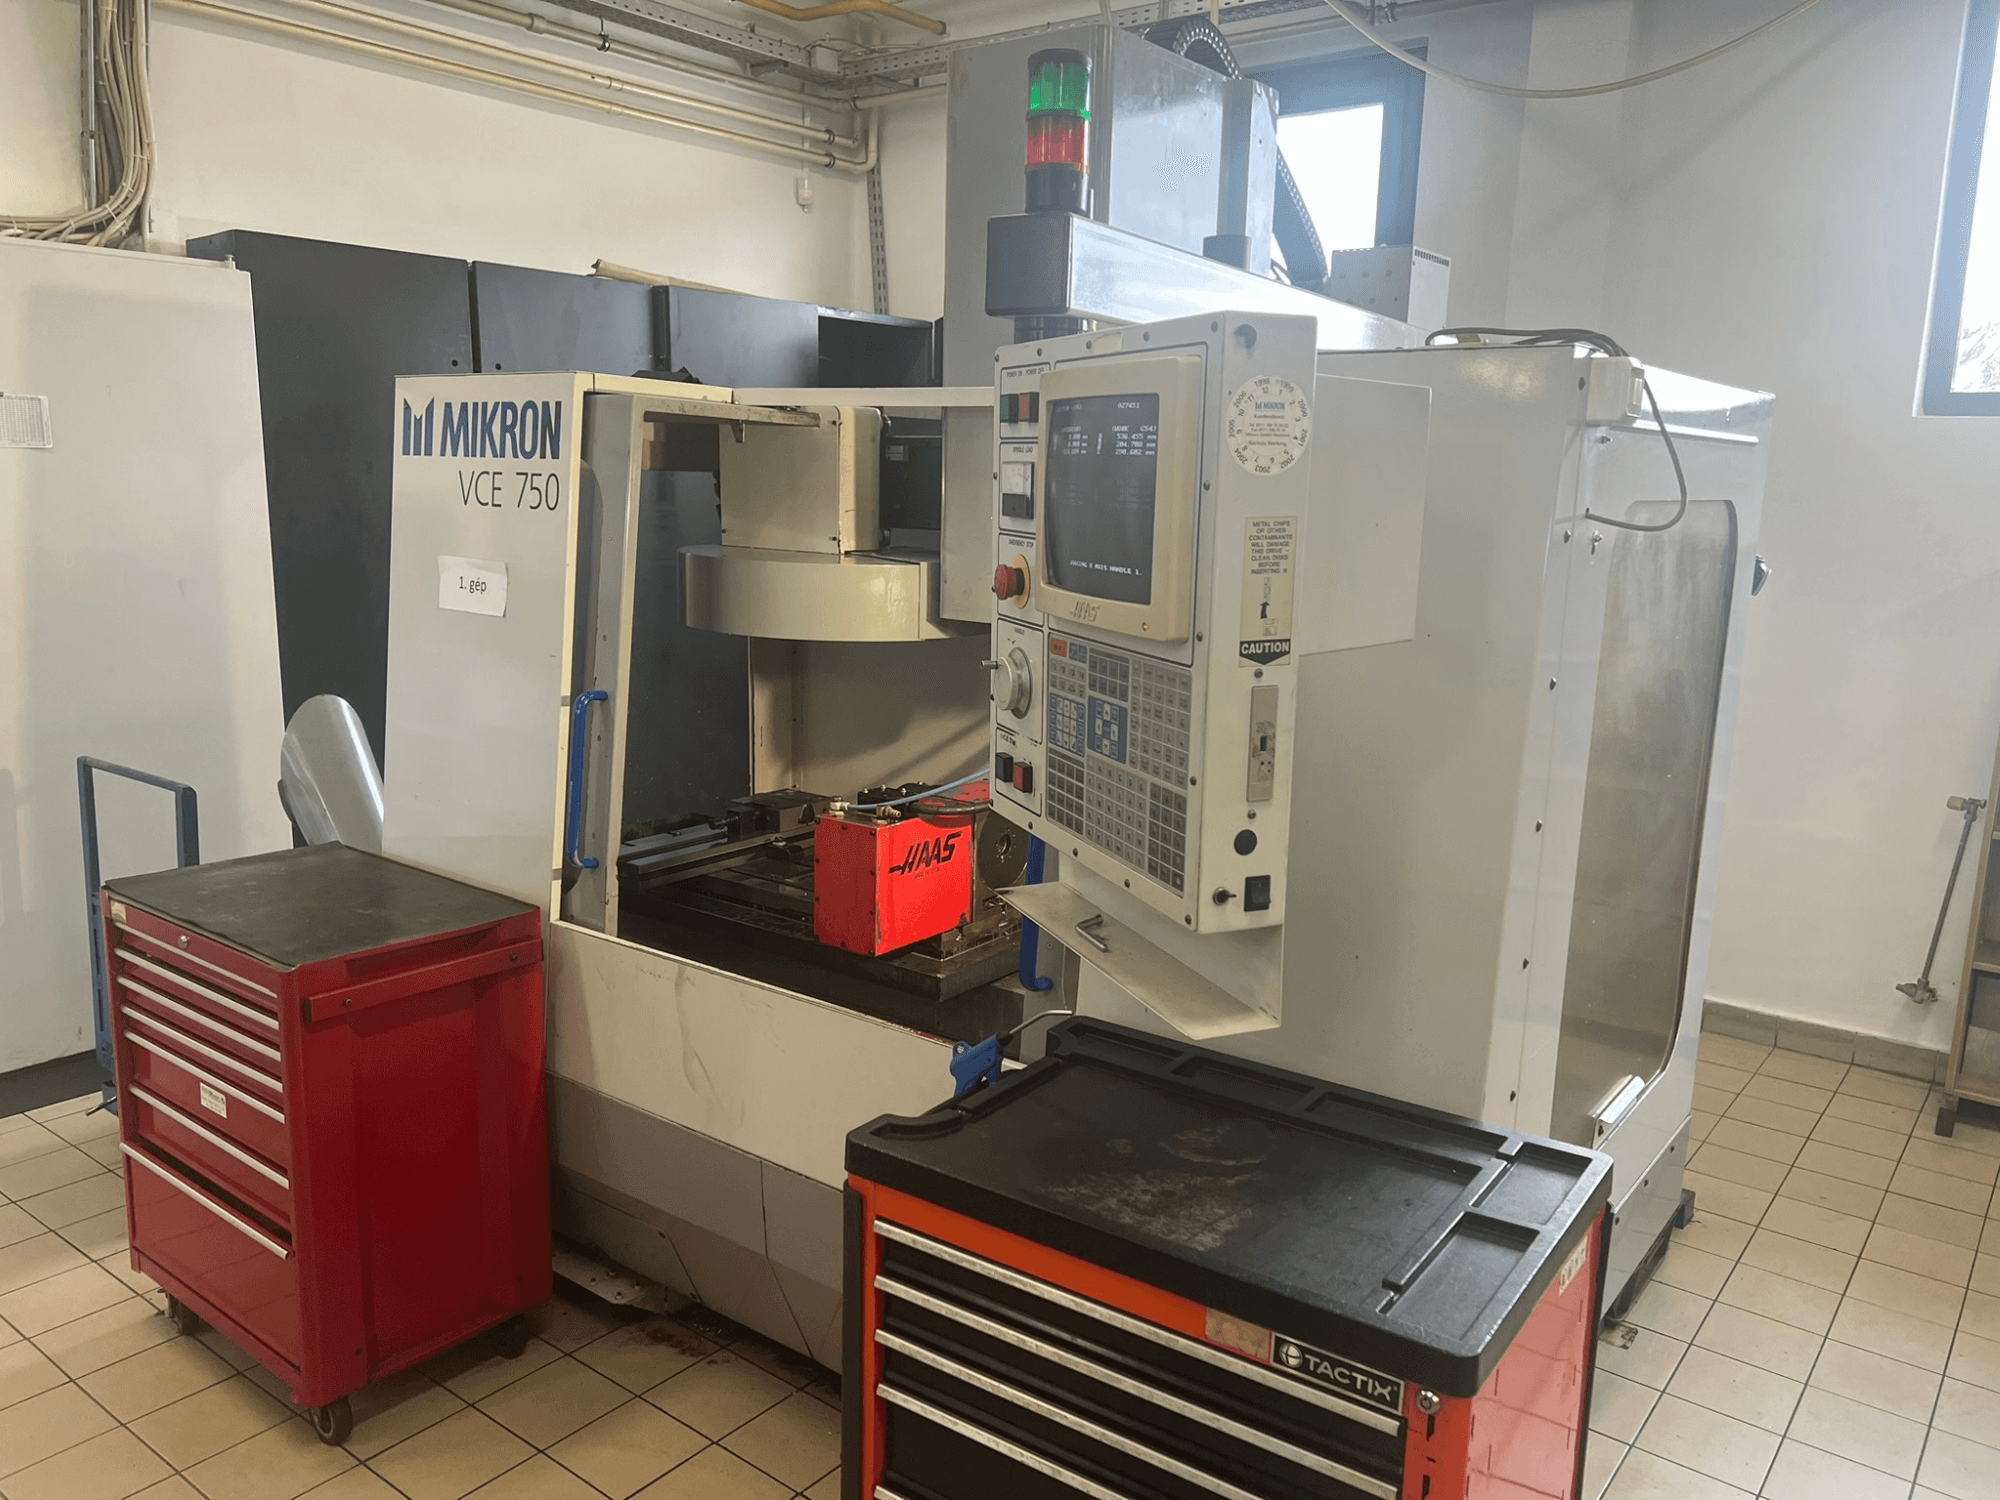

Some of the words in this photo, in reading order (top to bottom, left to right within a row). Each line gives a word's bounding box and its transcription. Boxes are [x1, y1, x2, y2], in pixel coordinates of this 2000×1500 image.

[1254, 378, 1270, 387] 1998
[1280, 380, 1294, 393] 1999
[1263, 401, 1285, 410] MIKRON
[1298, 399, 1308, 418] 2000
[440, 400, 562, 460] MIKRON
[459, 470, 503, 508] VCE
[515, 472, 560, 511] 750
[459, 576, 467, 590] 1.
[469, 577, 487, 595] gép
[1241, 641, 1290, 654] CAUTION
[888, 830, 963, 876] HAAS
[1305, 1353, 1392, 1401] TACTIX
